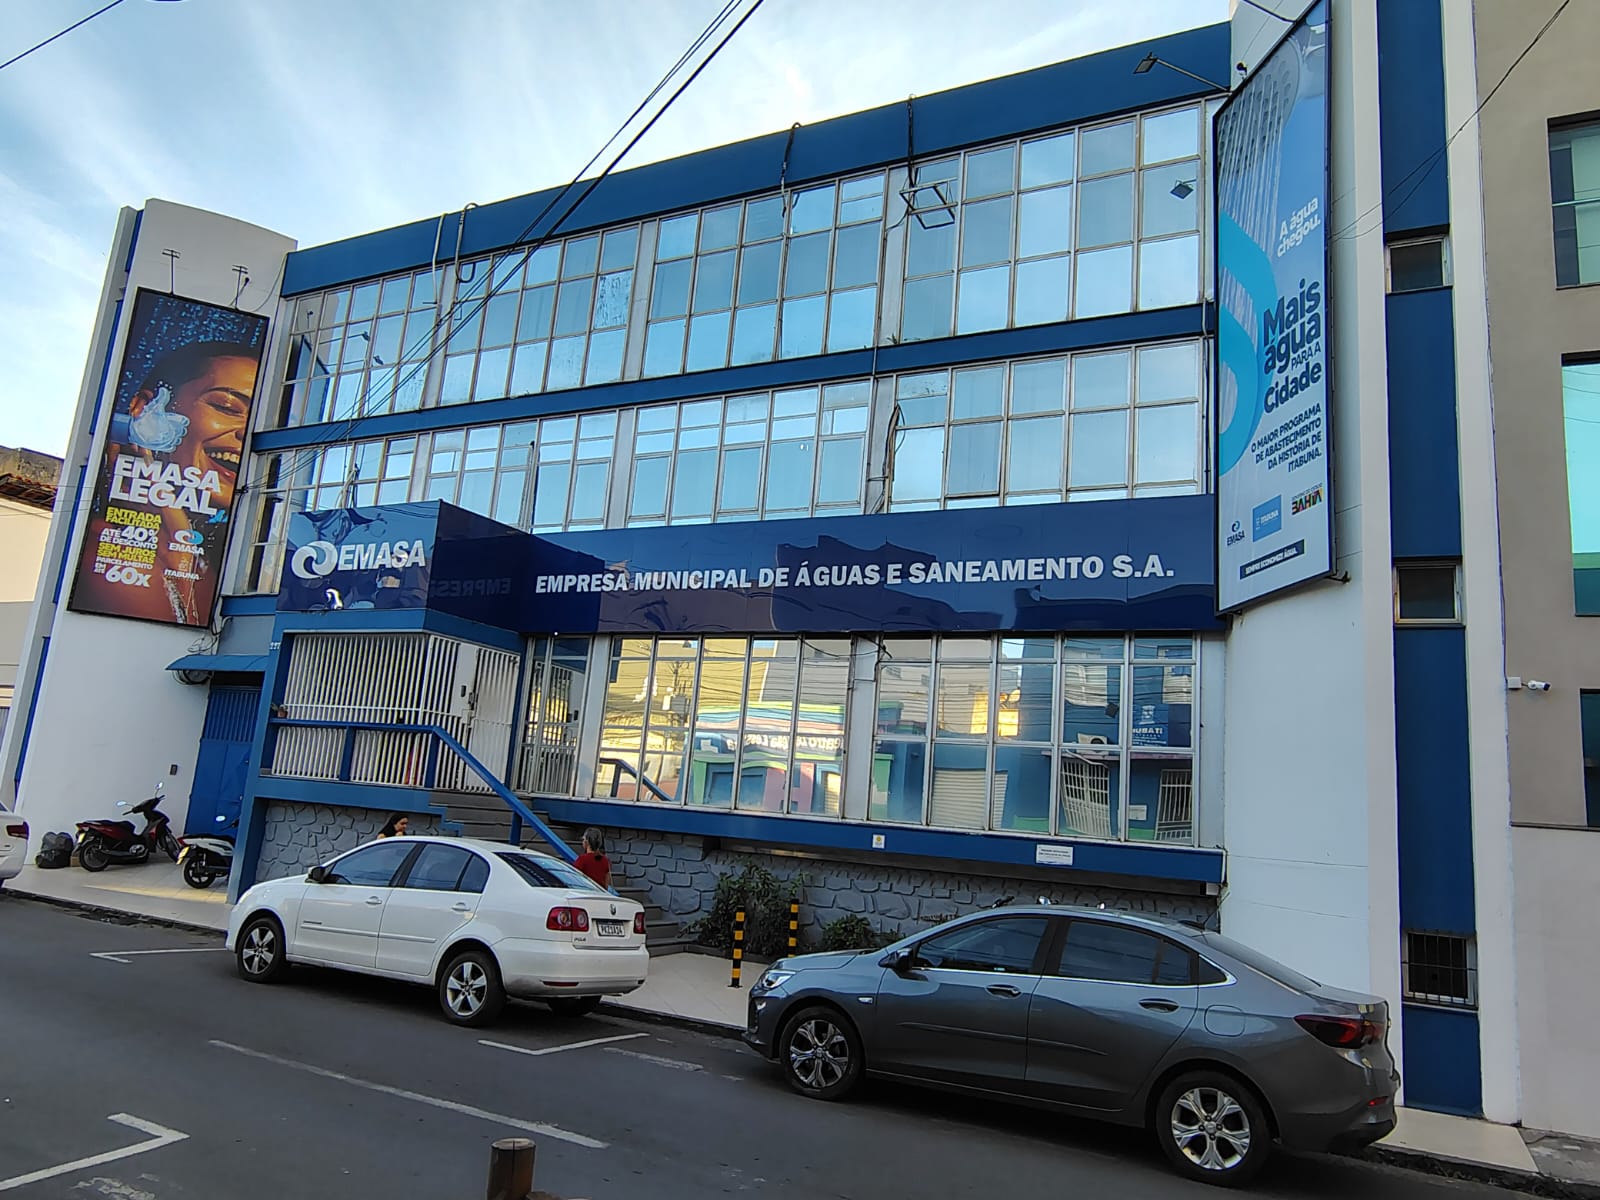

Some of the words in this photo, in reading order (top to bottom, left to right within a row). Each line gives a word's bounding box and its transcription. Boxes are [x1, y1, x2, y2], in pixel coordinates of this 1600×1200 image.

[1277, 214, 1321, 258] chegou.
[1279, 220, 1288, 241] A
[1290, 197, 1318, 230] água
[1263, 278, 1321, 347] Mais
[1263, 312, 1321, 375] água
[1291, 346, 1314, 372] PARA
[1313, 340, 1321, 354] A
[1263, 360, 1322, 414] Cidade
[1251, 443, 1256, 453] O
[1257, 428, 1278, 450] MAIOR
[1279, 403, 1321, 436] PROGRAMA
[1256, 450, 1264, 464] DE
[1265, 417, 1321, 458] ABASTECIMENTO
[1268, 456, 1278, 470] DA
[1278, 438, 1310, 465] HISTÓRIA
[1311, 430, 1322, 446] DE
[114, 454, 221, 494] EMASA
[109, 474, 217, 515] LEGAL
[101, 527, 121, 538] ATÉ
[121, 526, 159, 544] 40%
[105, 515, 160, 530] FACILITADA
[106, 506, 162, 524] ENTRADA
[97, 549, 117, 558] SEM
[118, 552, 155, 564] MULTAS
[99, 542, 121, 553] SEM
[122, 546, 156, 558] JUROS
[112, 537, 158, 550] DESCONTO
[169, 542, 205, 556] EMASA
[337, 539, 427, 572] EMASA
[1226, 530, 1245, 547] EMASA
[535, 570, 629, 594] EMPRESA
[633, 567, 752, 592] MUNICIPAL
[757, 566, 790, 588] DE
[794, 560, 881, 586] ÁGUAS
[886, 563, 902, 585] E
[908, 556, 1105, 584] SANEAMENTO
[1112, 554, 1175, 579] S.A.
